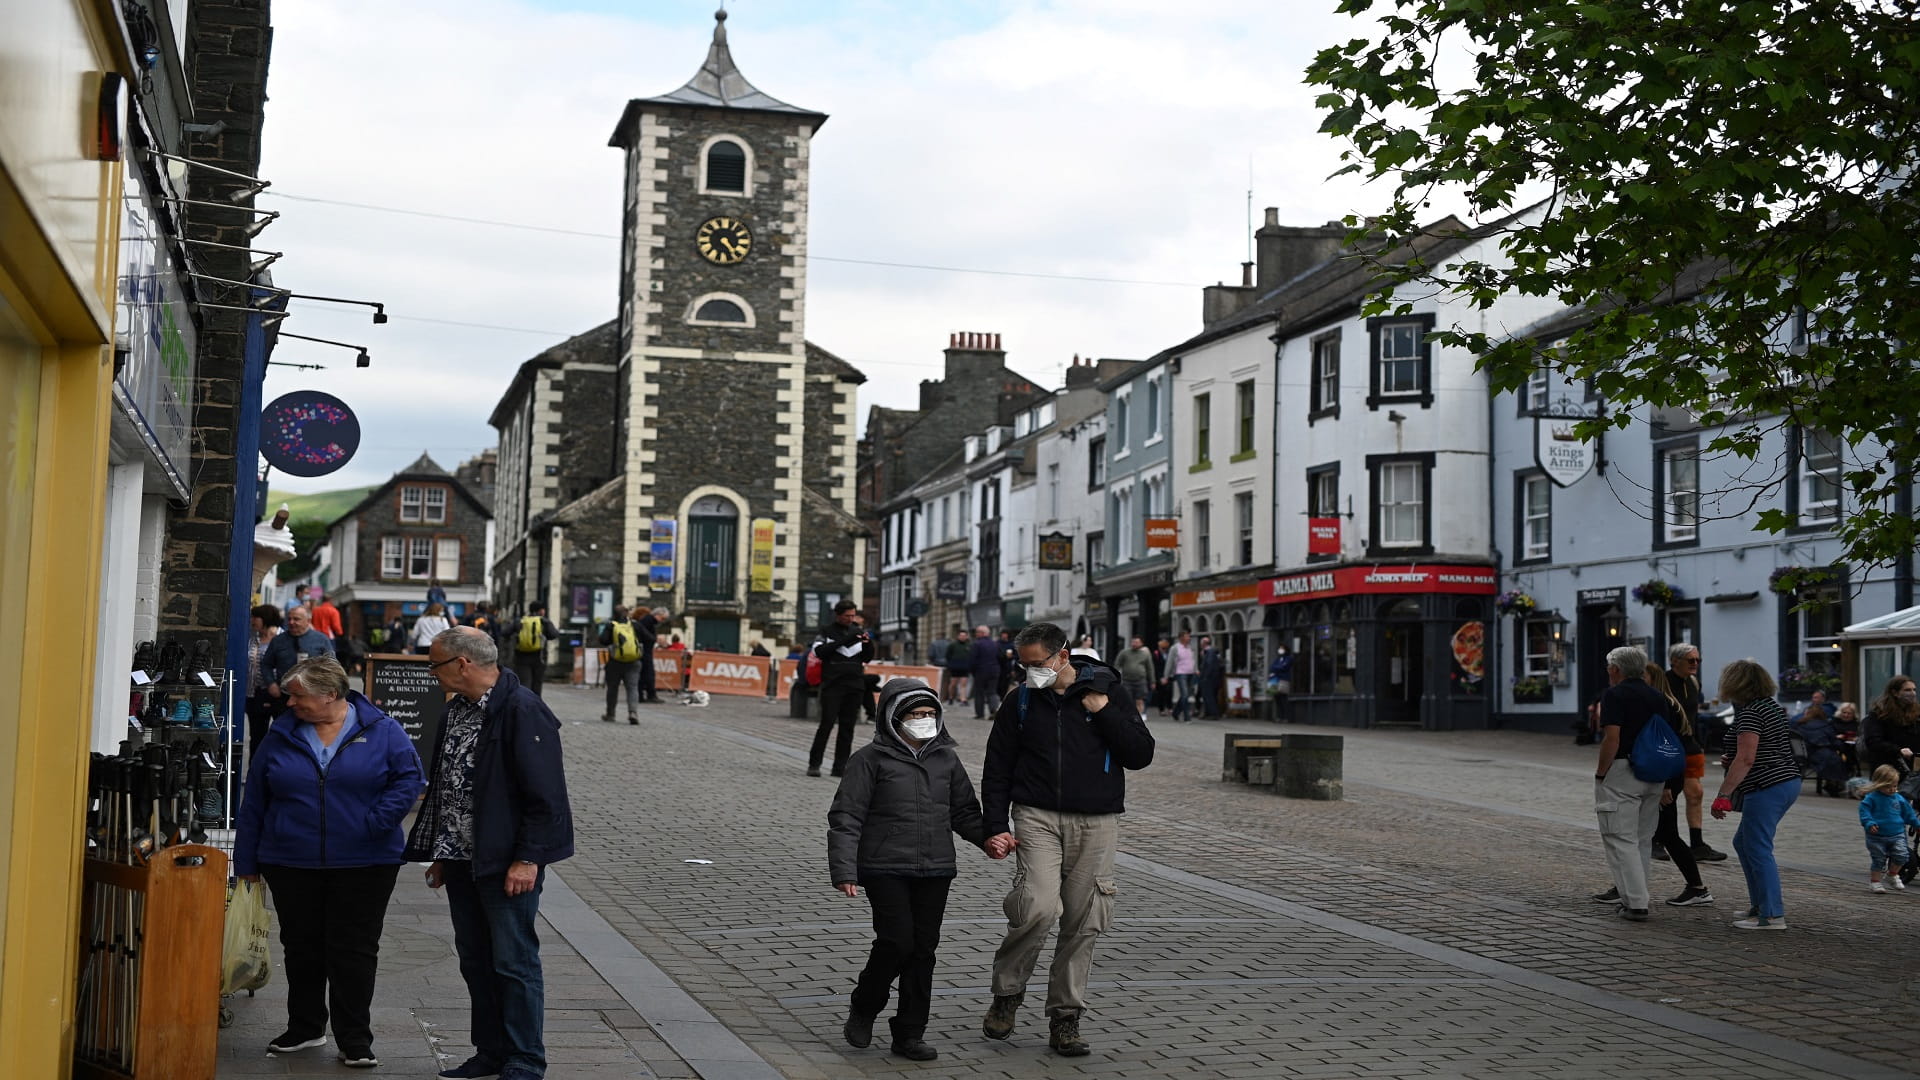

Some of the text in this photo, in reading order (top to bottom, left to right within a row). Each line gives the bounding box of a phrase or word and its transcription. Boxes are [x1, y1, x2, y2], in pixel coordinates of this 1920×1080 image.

[1549, 447, 1584, 459] Kings
[1549, 457, 1584, 468] Arms
[1147, 528, 1176, 536] JAVA
[1273, 573, 1335, 596] MAMA MIA
[1439, 574, 1495, 584] MAMA MIA
[377, 670, 402, 678] LOCAL
[653, 658, 762, 680] AVA JAVA
